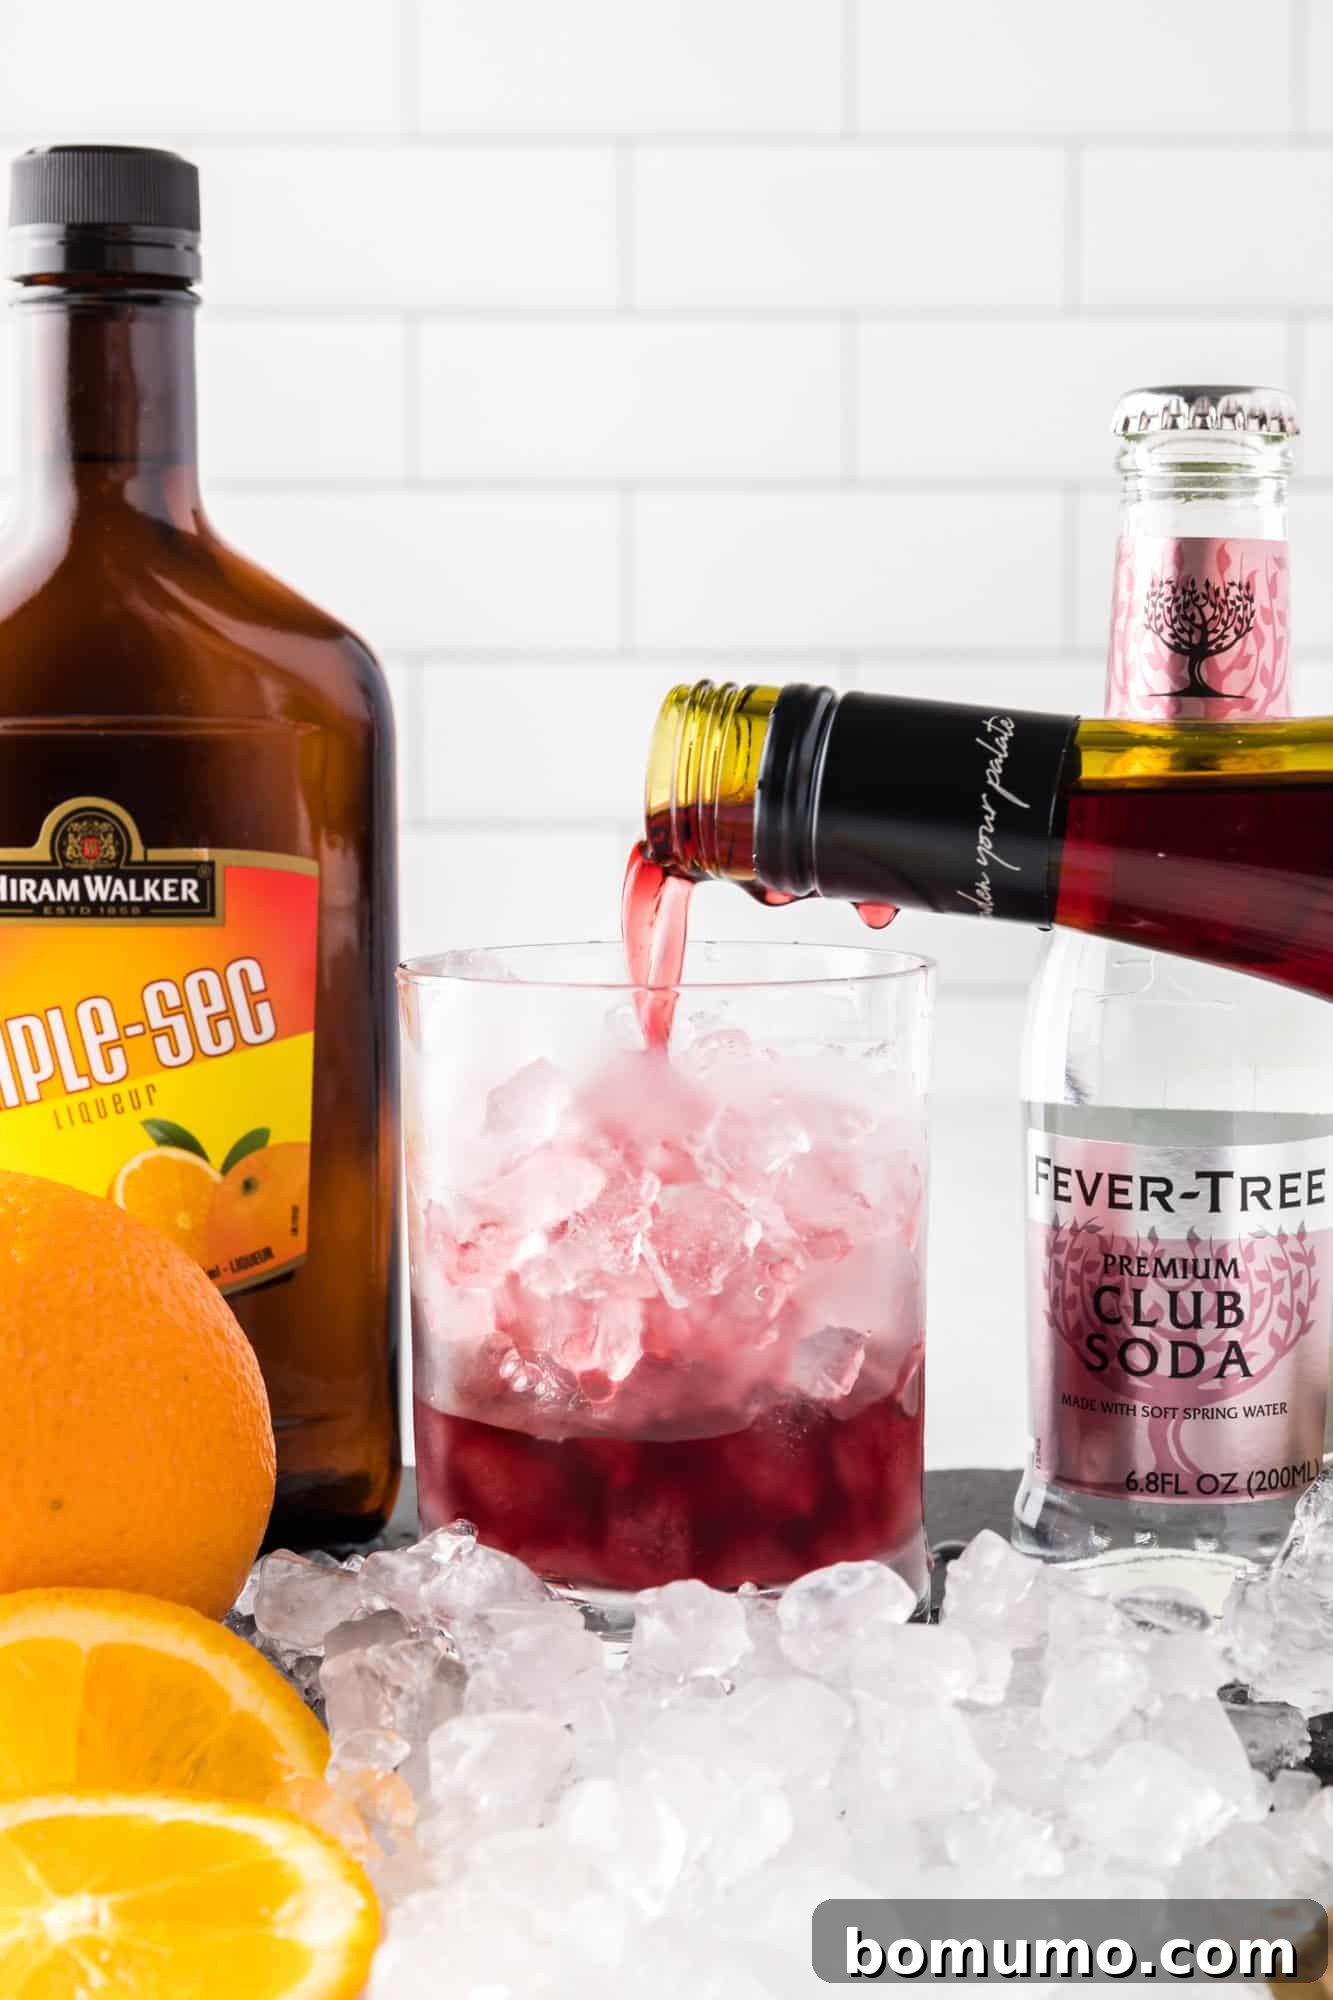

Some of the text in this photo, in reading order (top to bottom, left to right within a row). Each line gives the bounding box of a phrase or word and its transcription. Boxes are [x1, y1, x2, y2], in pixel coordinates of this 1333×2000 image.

[975, 715, 1030, 808] palate
[976, 793, 1021, 871] your
[83, 875, 200, 903] WALKER
[1035, 1155, 1326, 1213] FEVER-TREE
[1102, 1253, 1240, 1279] PREMIUM
[1093, 1285, 1245, 1330] CLUB
[1085, 1334, 1253, 1379] SODA
[1061, 1392, 1288, 1419] MADE WITH SOFT SPRING WATER
[1125, 1458, 1320, 1498] 6.8FL OZ (200ML)
